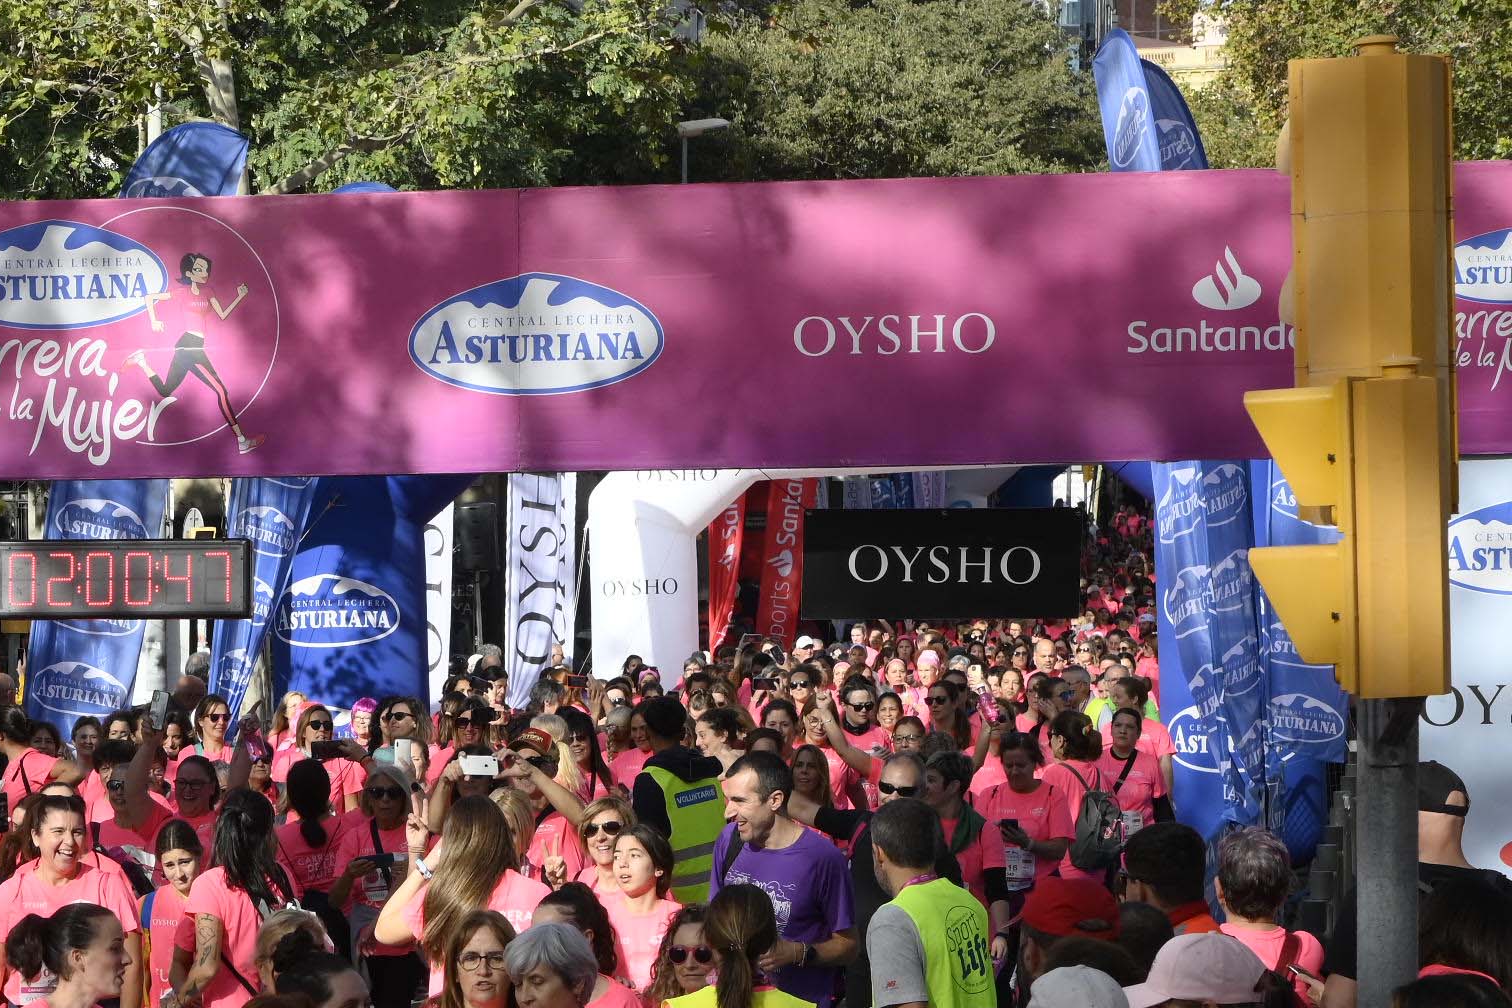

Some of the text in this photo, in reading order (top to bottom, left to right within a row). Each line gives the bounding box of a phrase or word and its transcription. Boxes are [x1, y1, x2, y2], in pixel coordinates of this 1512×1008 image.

[72, 255, 143, 269] LECHERA
[467, 313, 635, 329] CENTRAL LECHERA
[793, 313, 995, 357] OYSHO
[1127, 319, 1294, 354] Santand
[429, 320, 644, 365] ASTURIANA
[1478, 339, 1495, 367] la
[9, 381, 34, 420] la
[29, 372, 178, 466] Mujer
[8, 551, 234, 607] 02:00:47
[848, 544, 1041, 585] OYSHO
[291, 599, 387, 608] CENTRAL LECHERA
[603, 577, 678, 597] OYSHO
[277, 608, 391, 632] ASTURIANA
[37, 677, 121, 709] ASTURIANA
[1420, 684, 1512, 727] OY
[676, 786, 716, 805] VOLUNTARIS
[946, 911, 979, 953] Sport
